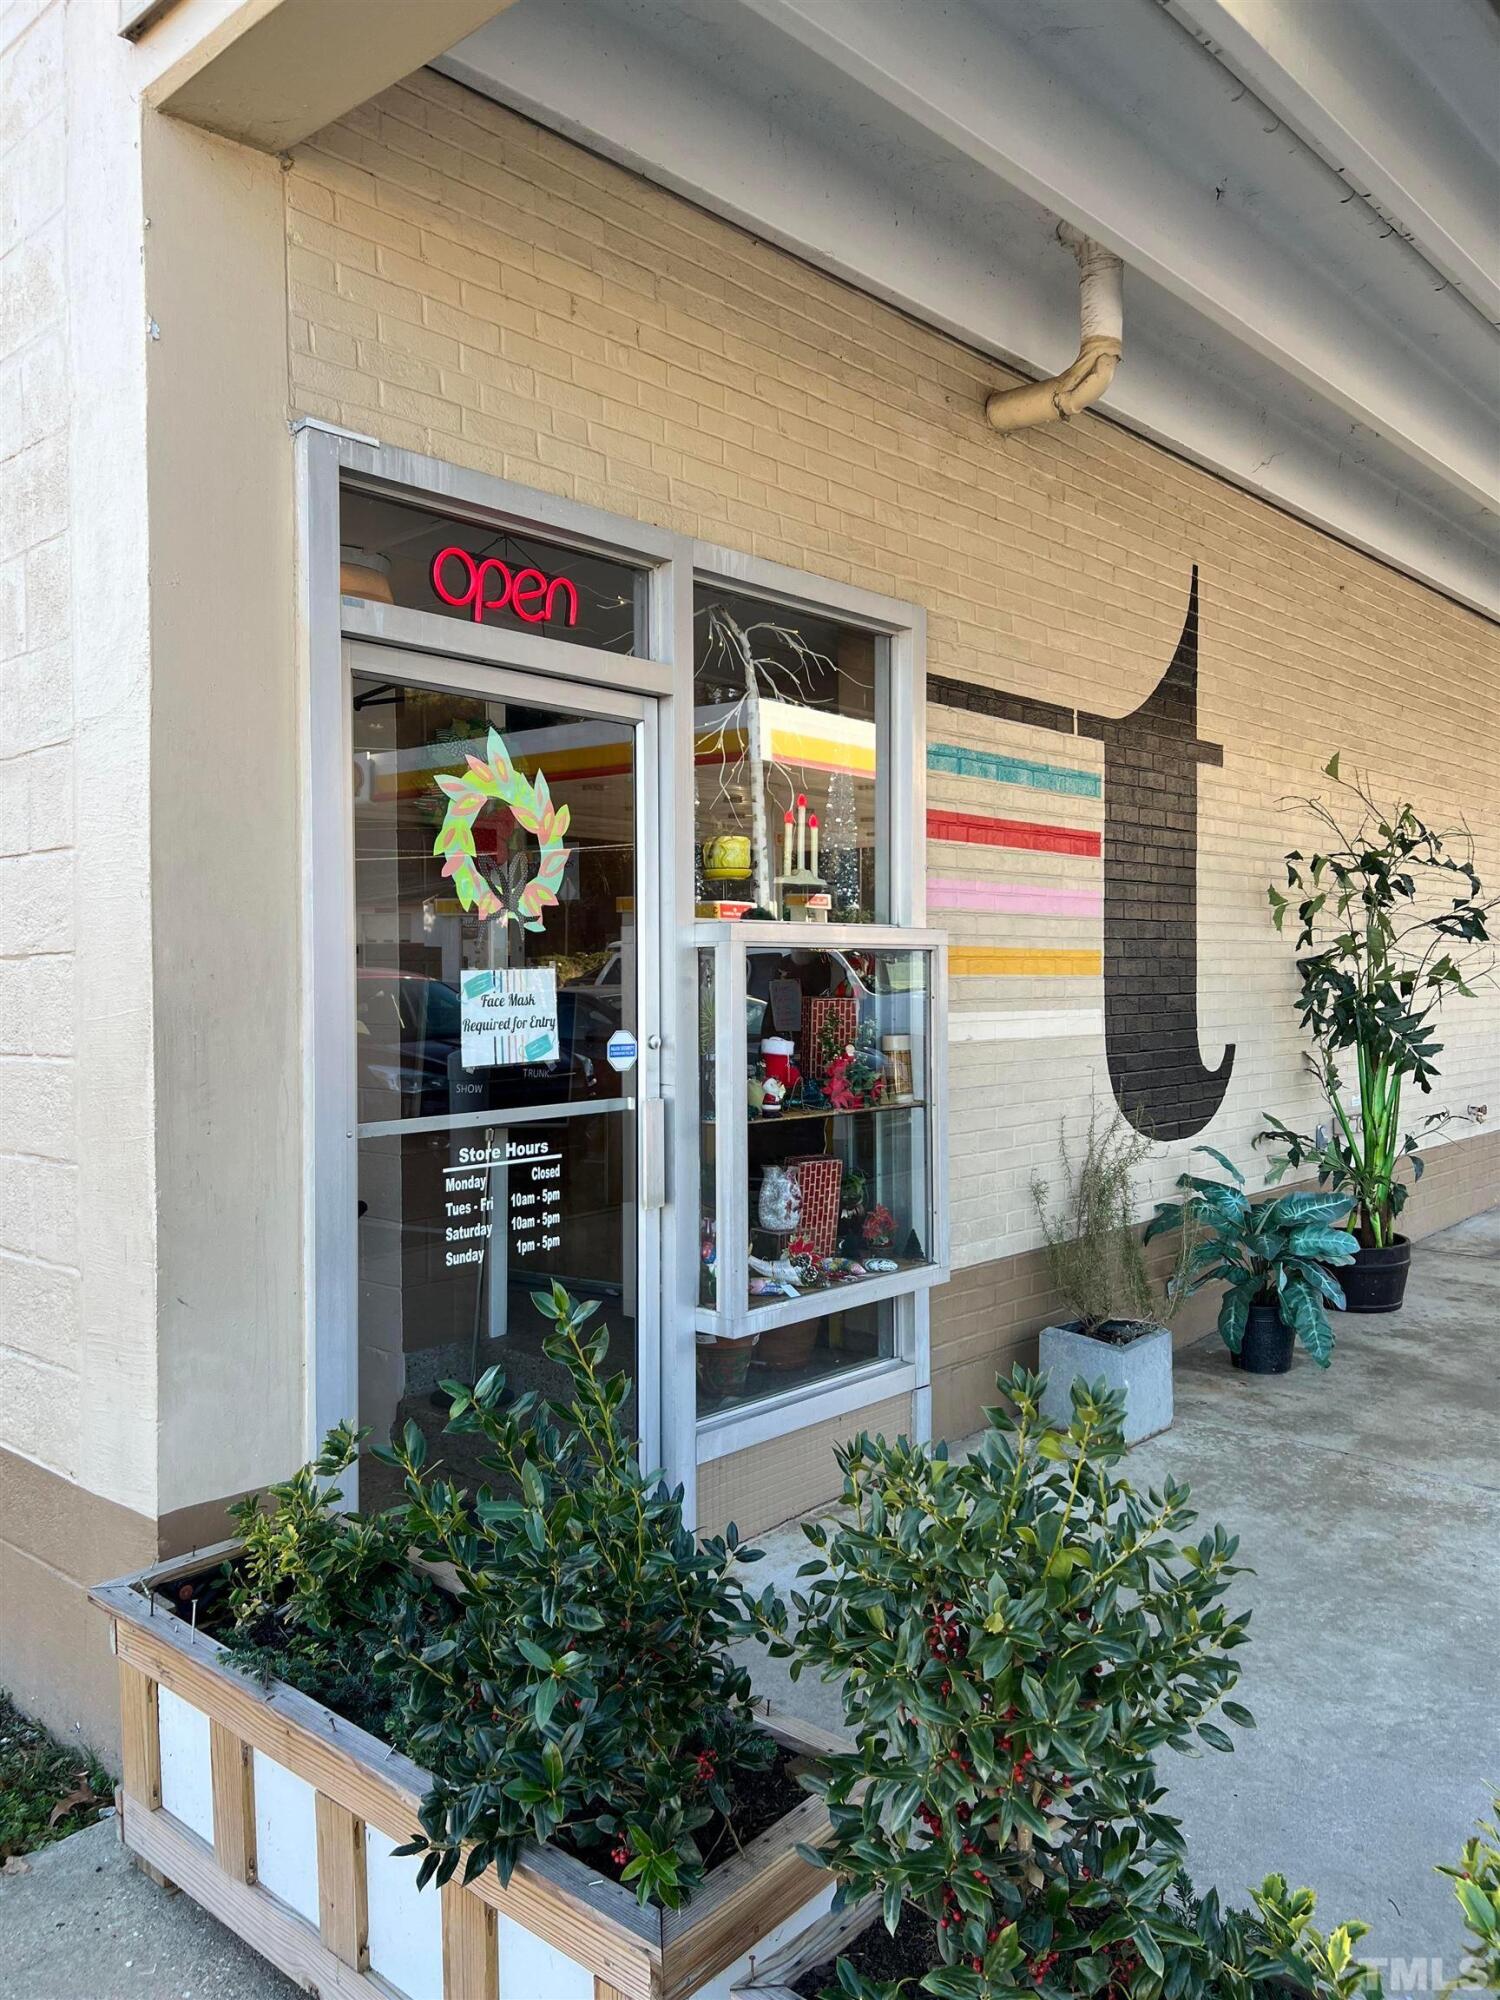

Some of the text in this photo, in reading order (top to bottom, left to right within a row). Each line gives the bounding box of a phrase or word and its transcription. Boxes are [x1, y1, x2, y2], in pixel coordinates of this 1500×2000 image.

[432, 547, 578, 626] open
[481, 992, 536, 1008] Face Mask
[462, 1015, 556, 1035] Required for Entry
[456, 1083, 483, 1094] SHOW
[458, 1142, 549, 1163] Store Hours
[445, 1164, 561, 1192] Monday Closed
[445, 1202, 471, 1217] Tues
[480, 1196, 494, 1212] Fri
[510, 1193, 535, 1207] 10am
[542, 1188, 560, 1205] 5pm
[445, 1222, 493, 1241] Saturday
[511, 1216, 535, 1230] 10am
[542, 1212, 560, 1229] 5pm
[445, 1248, 485, 1266] Sunday
[516, 1239, 535, 1256] 1pm
[542, 1235, 560, 1251] 5pm
